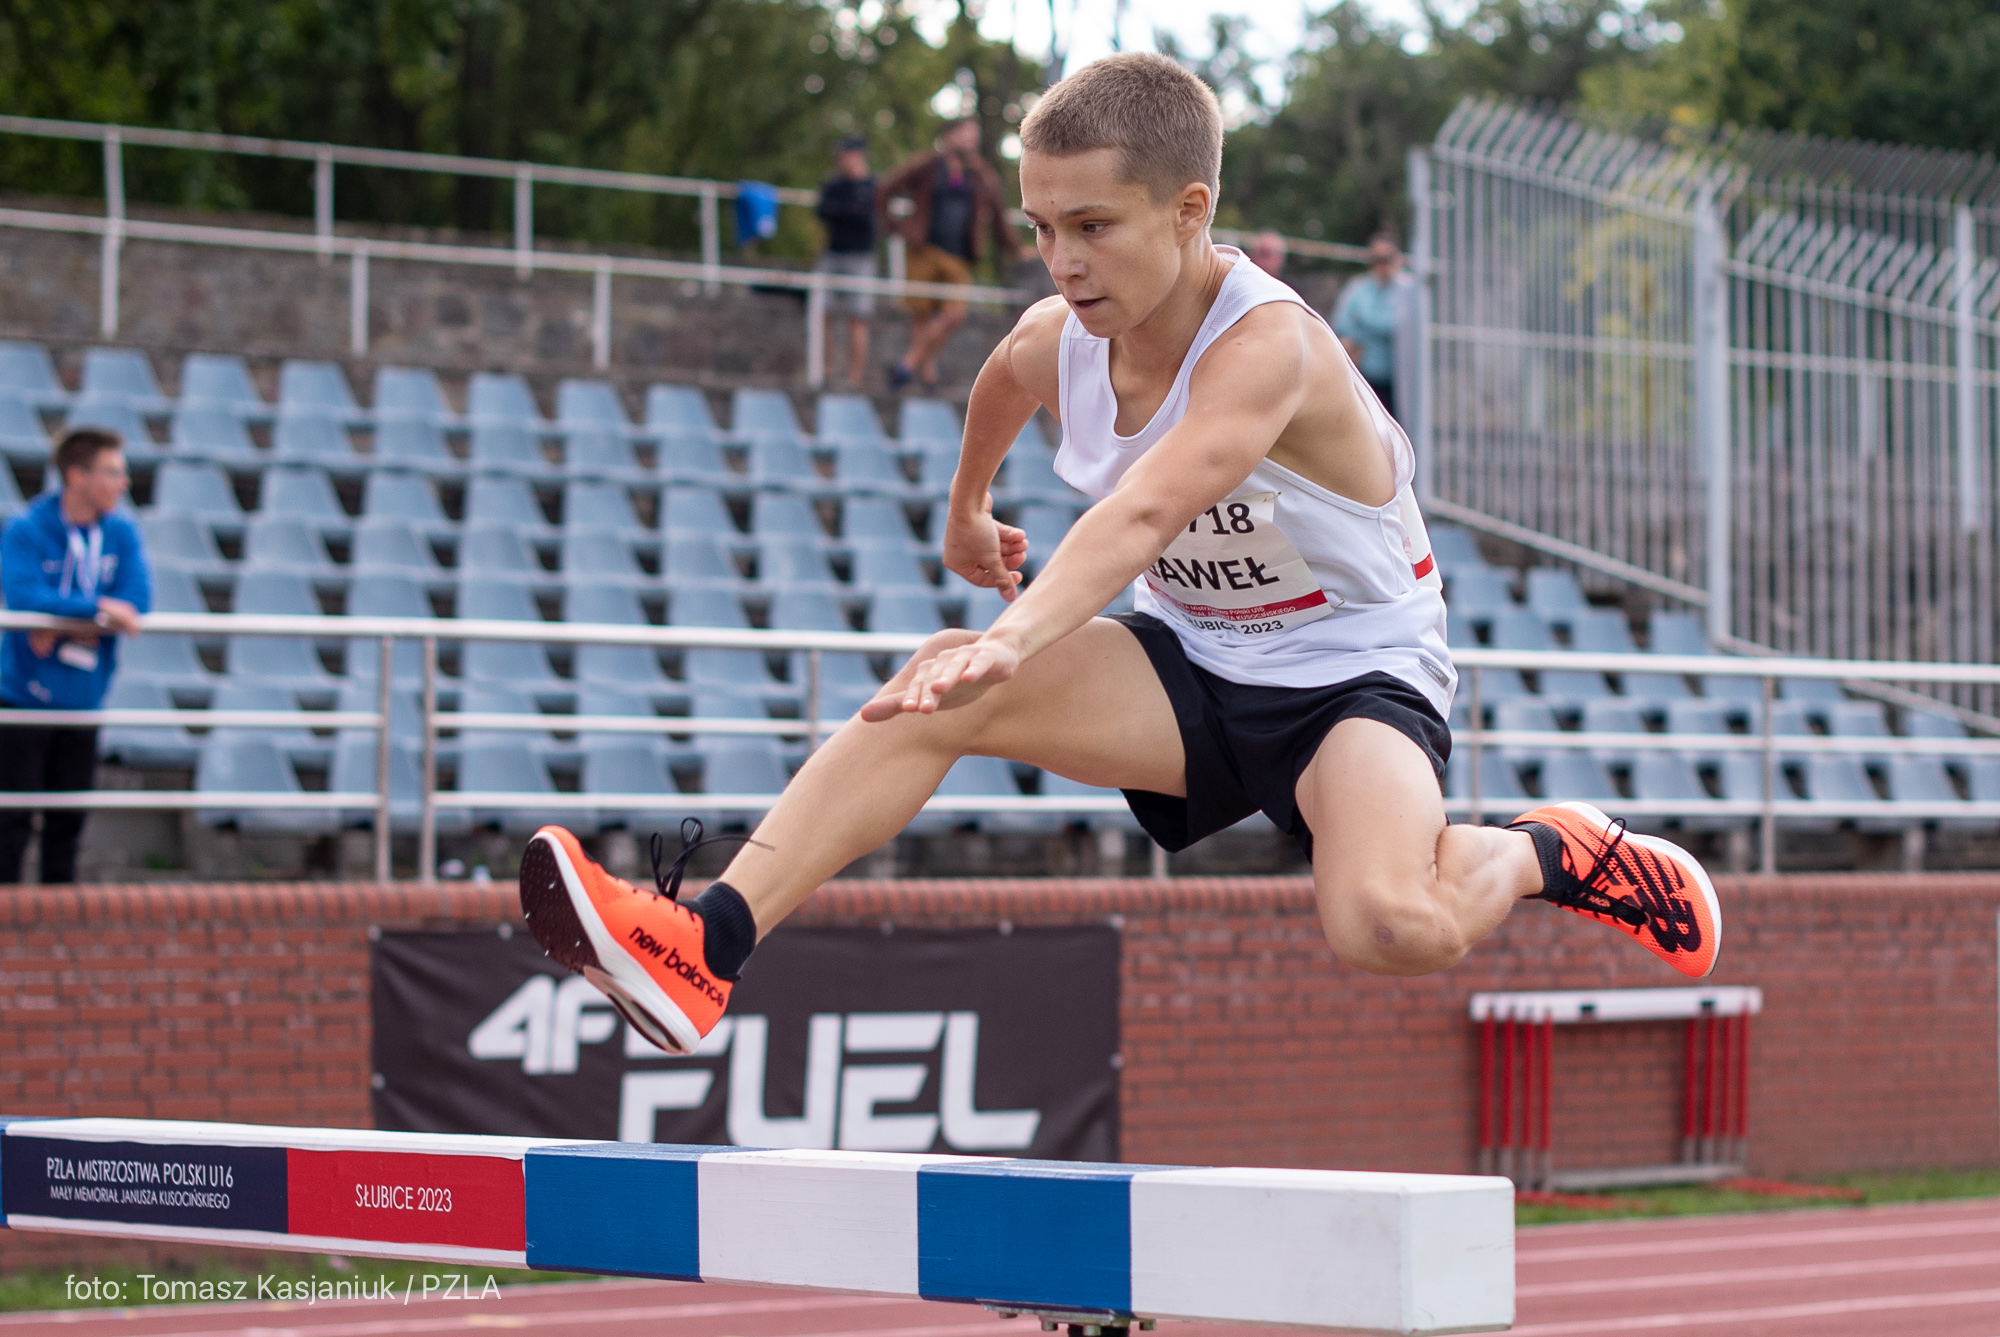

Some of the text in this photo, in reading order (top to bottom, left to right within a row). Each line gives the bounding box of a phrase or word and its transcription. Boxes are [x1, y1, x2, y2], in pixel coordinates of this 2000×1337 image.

[1241, 620, 1284, 634] 2023
[629, 927, 725, 1007] new balance
[468, 973, 618, 1075] 4F
[618, 1011, 1042, 1150] FUEL
[46, 1157, 234, 1188] PZLA MISTRZOSTWA POLSKI U16
[50, 1185, 231, 1210] MAŁY MEMORIAŁ JANUSZA KUSOCIŃSKIEGO
[355, 1183, 453, 1213] SŁUBICE 2023
